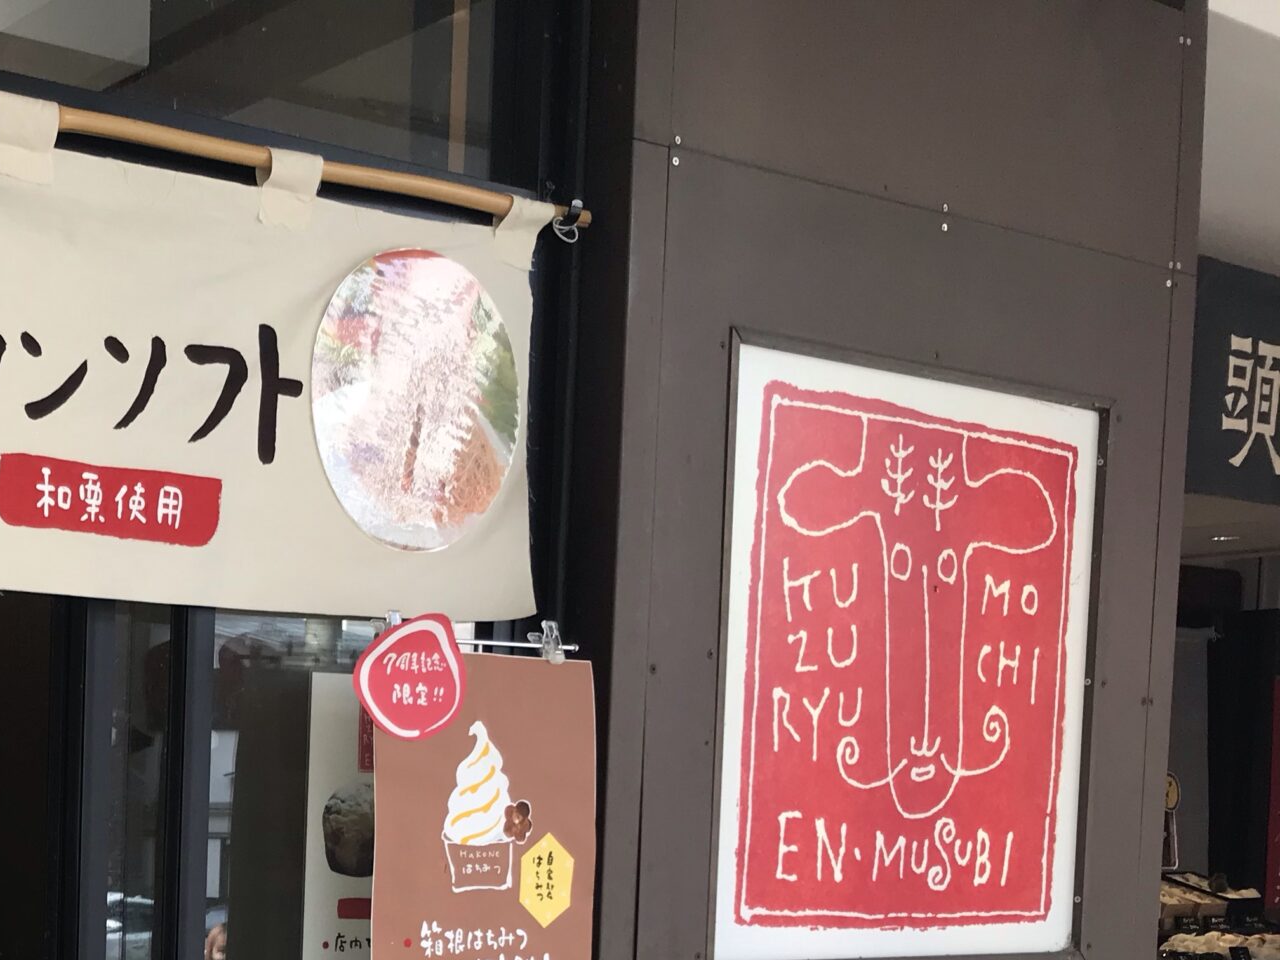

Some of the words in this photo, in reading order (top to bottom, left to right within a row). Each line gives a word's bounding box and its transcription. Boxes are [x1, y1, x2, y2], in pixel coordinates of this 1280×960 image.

[35, 466, 185, 530] 和栗使用
[981, 574, 1039, 616] MO
[977, 641, 1041, 705] CHI
[772, 686, 863, 762] RYU
[420, 920, 529, 959] 箱根はちみつ
